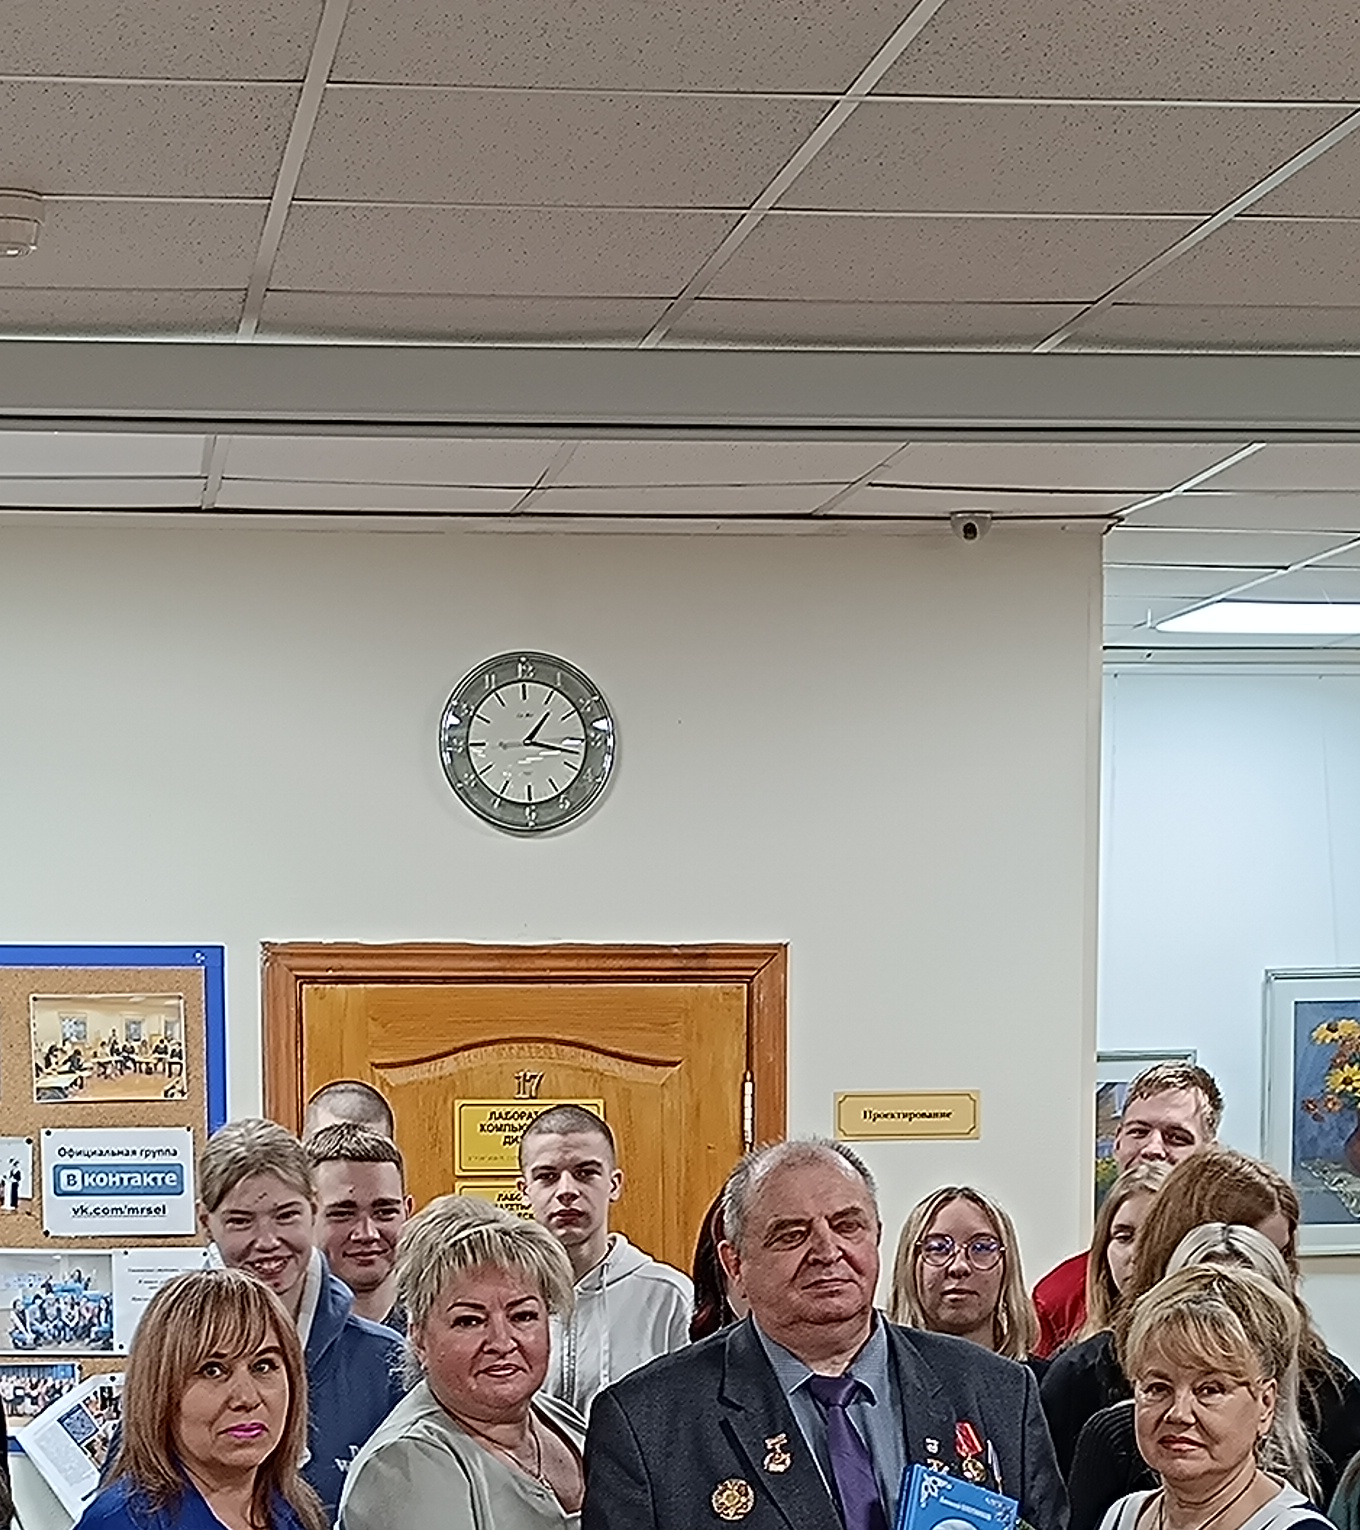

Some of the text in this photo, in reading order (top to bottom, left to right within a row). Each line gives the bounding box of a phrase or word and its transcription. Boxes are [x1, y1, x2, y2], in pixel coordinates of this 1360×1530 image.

[514, 1069, 544, 1099] 17
[862, 1109, 953, 1122] Проектирование
[57, 1147, 178, 1159] Официальная группа
